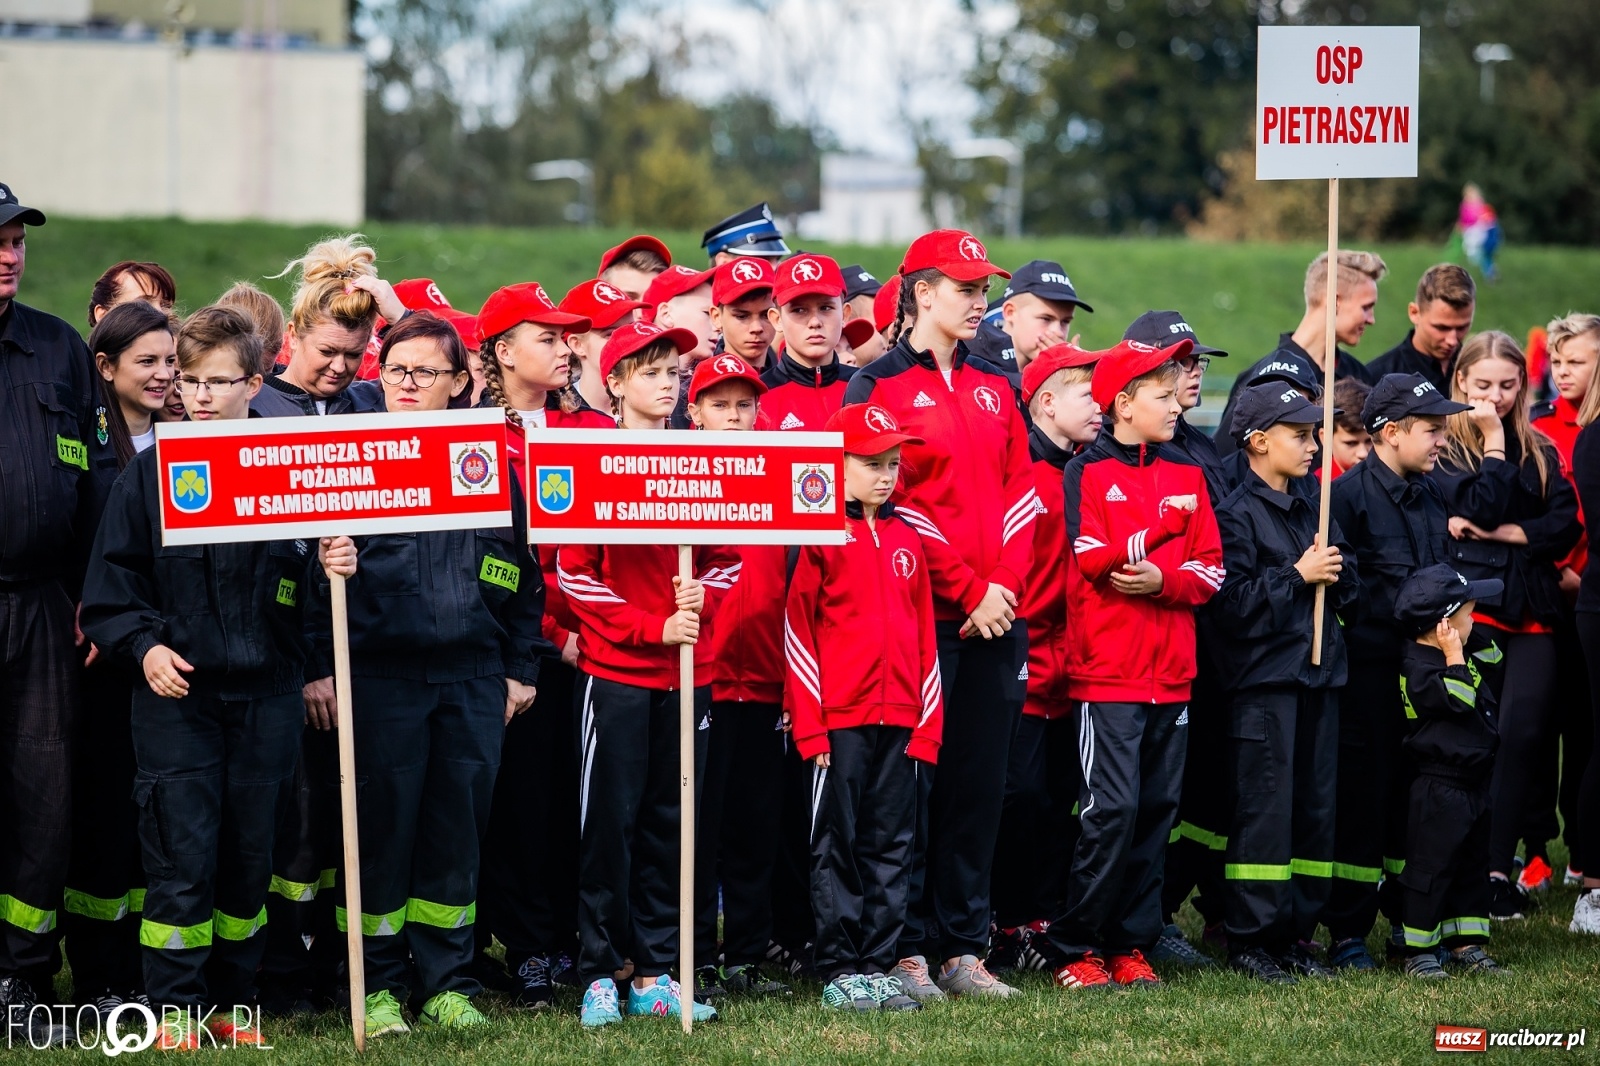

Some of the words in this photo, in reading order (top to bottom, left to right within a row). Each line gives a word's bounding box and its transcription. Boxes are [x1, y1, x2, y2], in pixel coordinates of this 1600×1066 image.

[1316, 45, 1363, 84] OSP
[1263, 105, 1410, 144] PIETRASZYN
[239, 442, 362, 467] OCHOTNICZA
[363, 436, 422, 462] STRAŻ
[600, 455, 710, 475] OCHOTNICZA
[712, 454, 766, 476] STRAŻ
[289, 465, 376, 490] POŻARNA
[645, 476, 723, 499] POŻARNA
[234, 496, 256, 517] W
[259, 487, 432, 516] SAMBOROWICACH
[594, 501, 613, 521] W
[616, 502, 773, 522] SAMBOROWICACH
